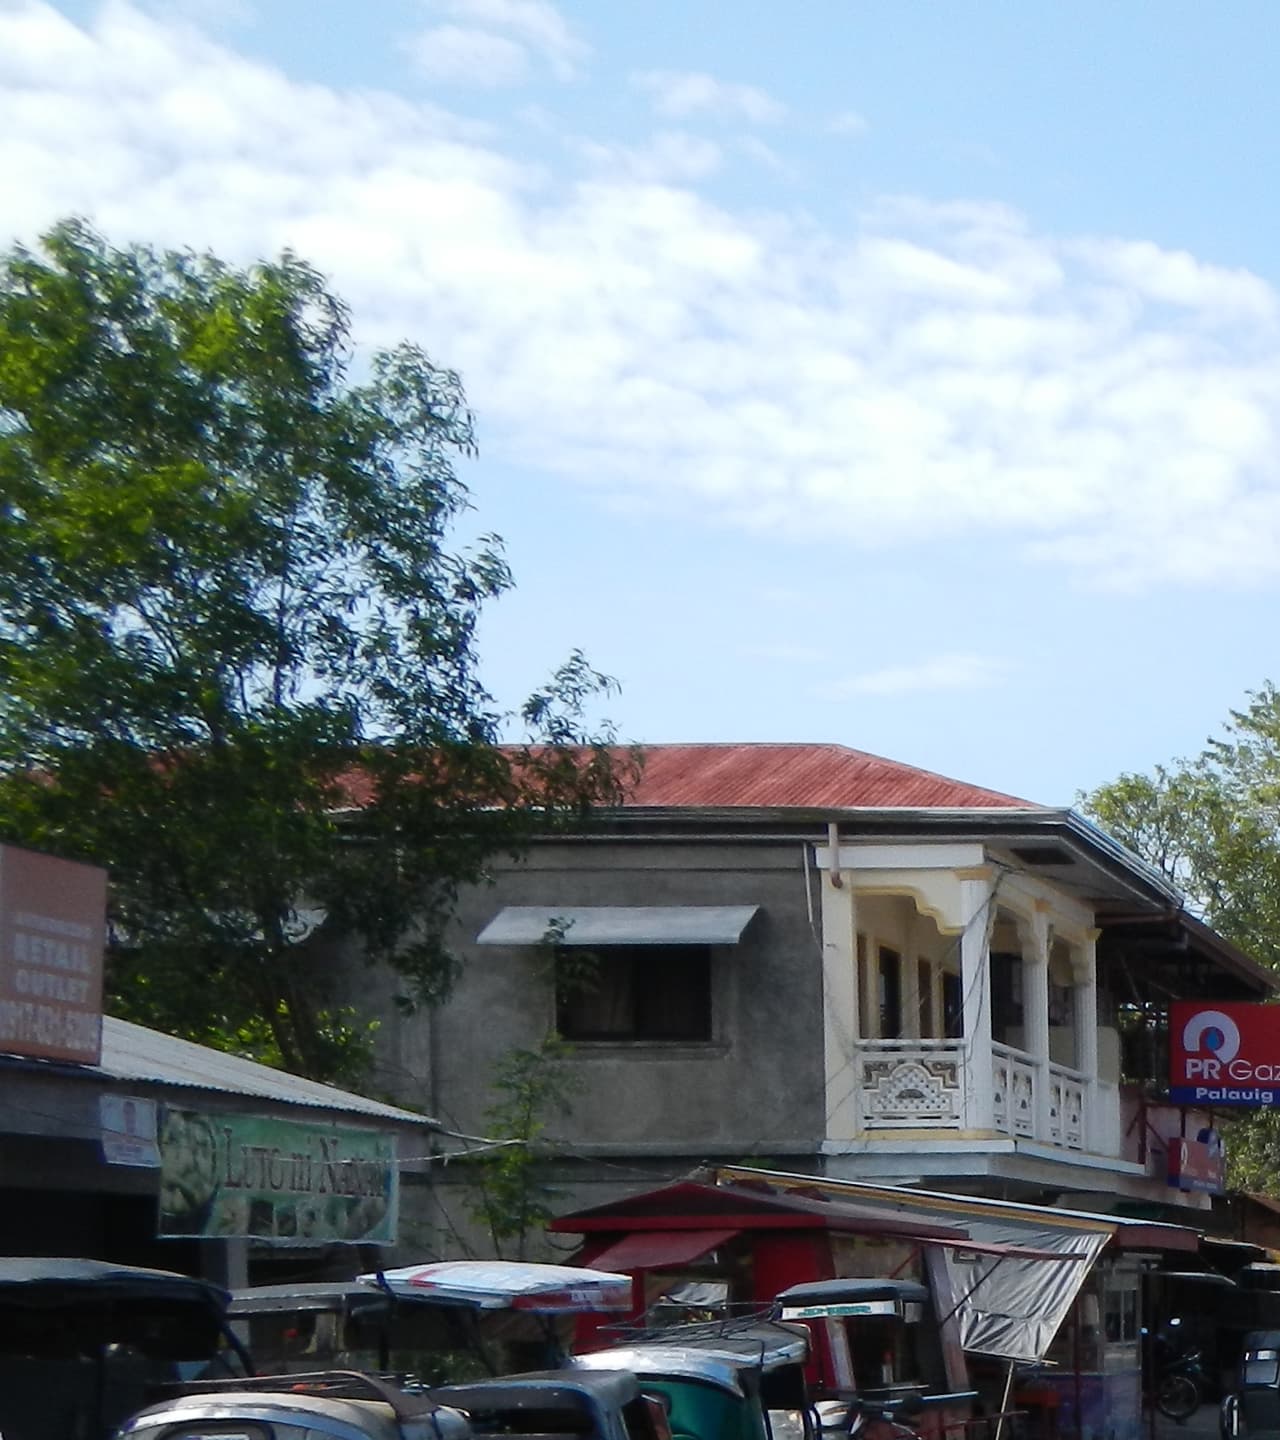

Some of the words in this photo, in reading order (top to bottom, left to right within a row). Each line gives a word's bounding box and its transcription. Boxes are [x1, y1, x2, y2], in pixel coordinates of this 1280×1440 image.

[13, 934, 90, 975] RETAIL
[14, 969, 90, 1004] OUTLET
[1186, 1059, 1221, 1080] PR
[1196, 1088, 1273, 1103] Palauig
